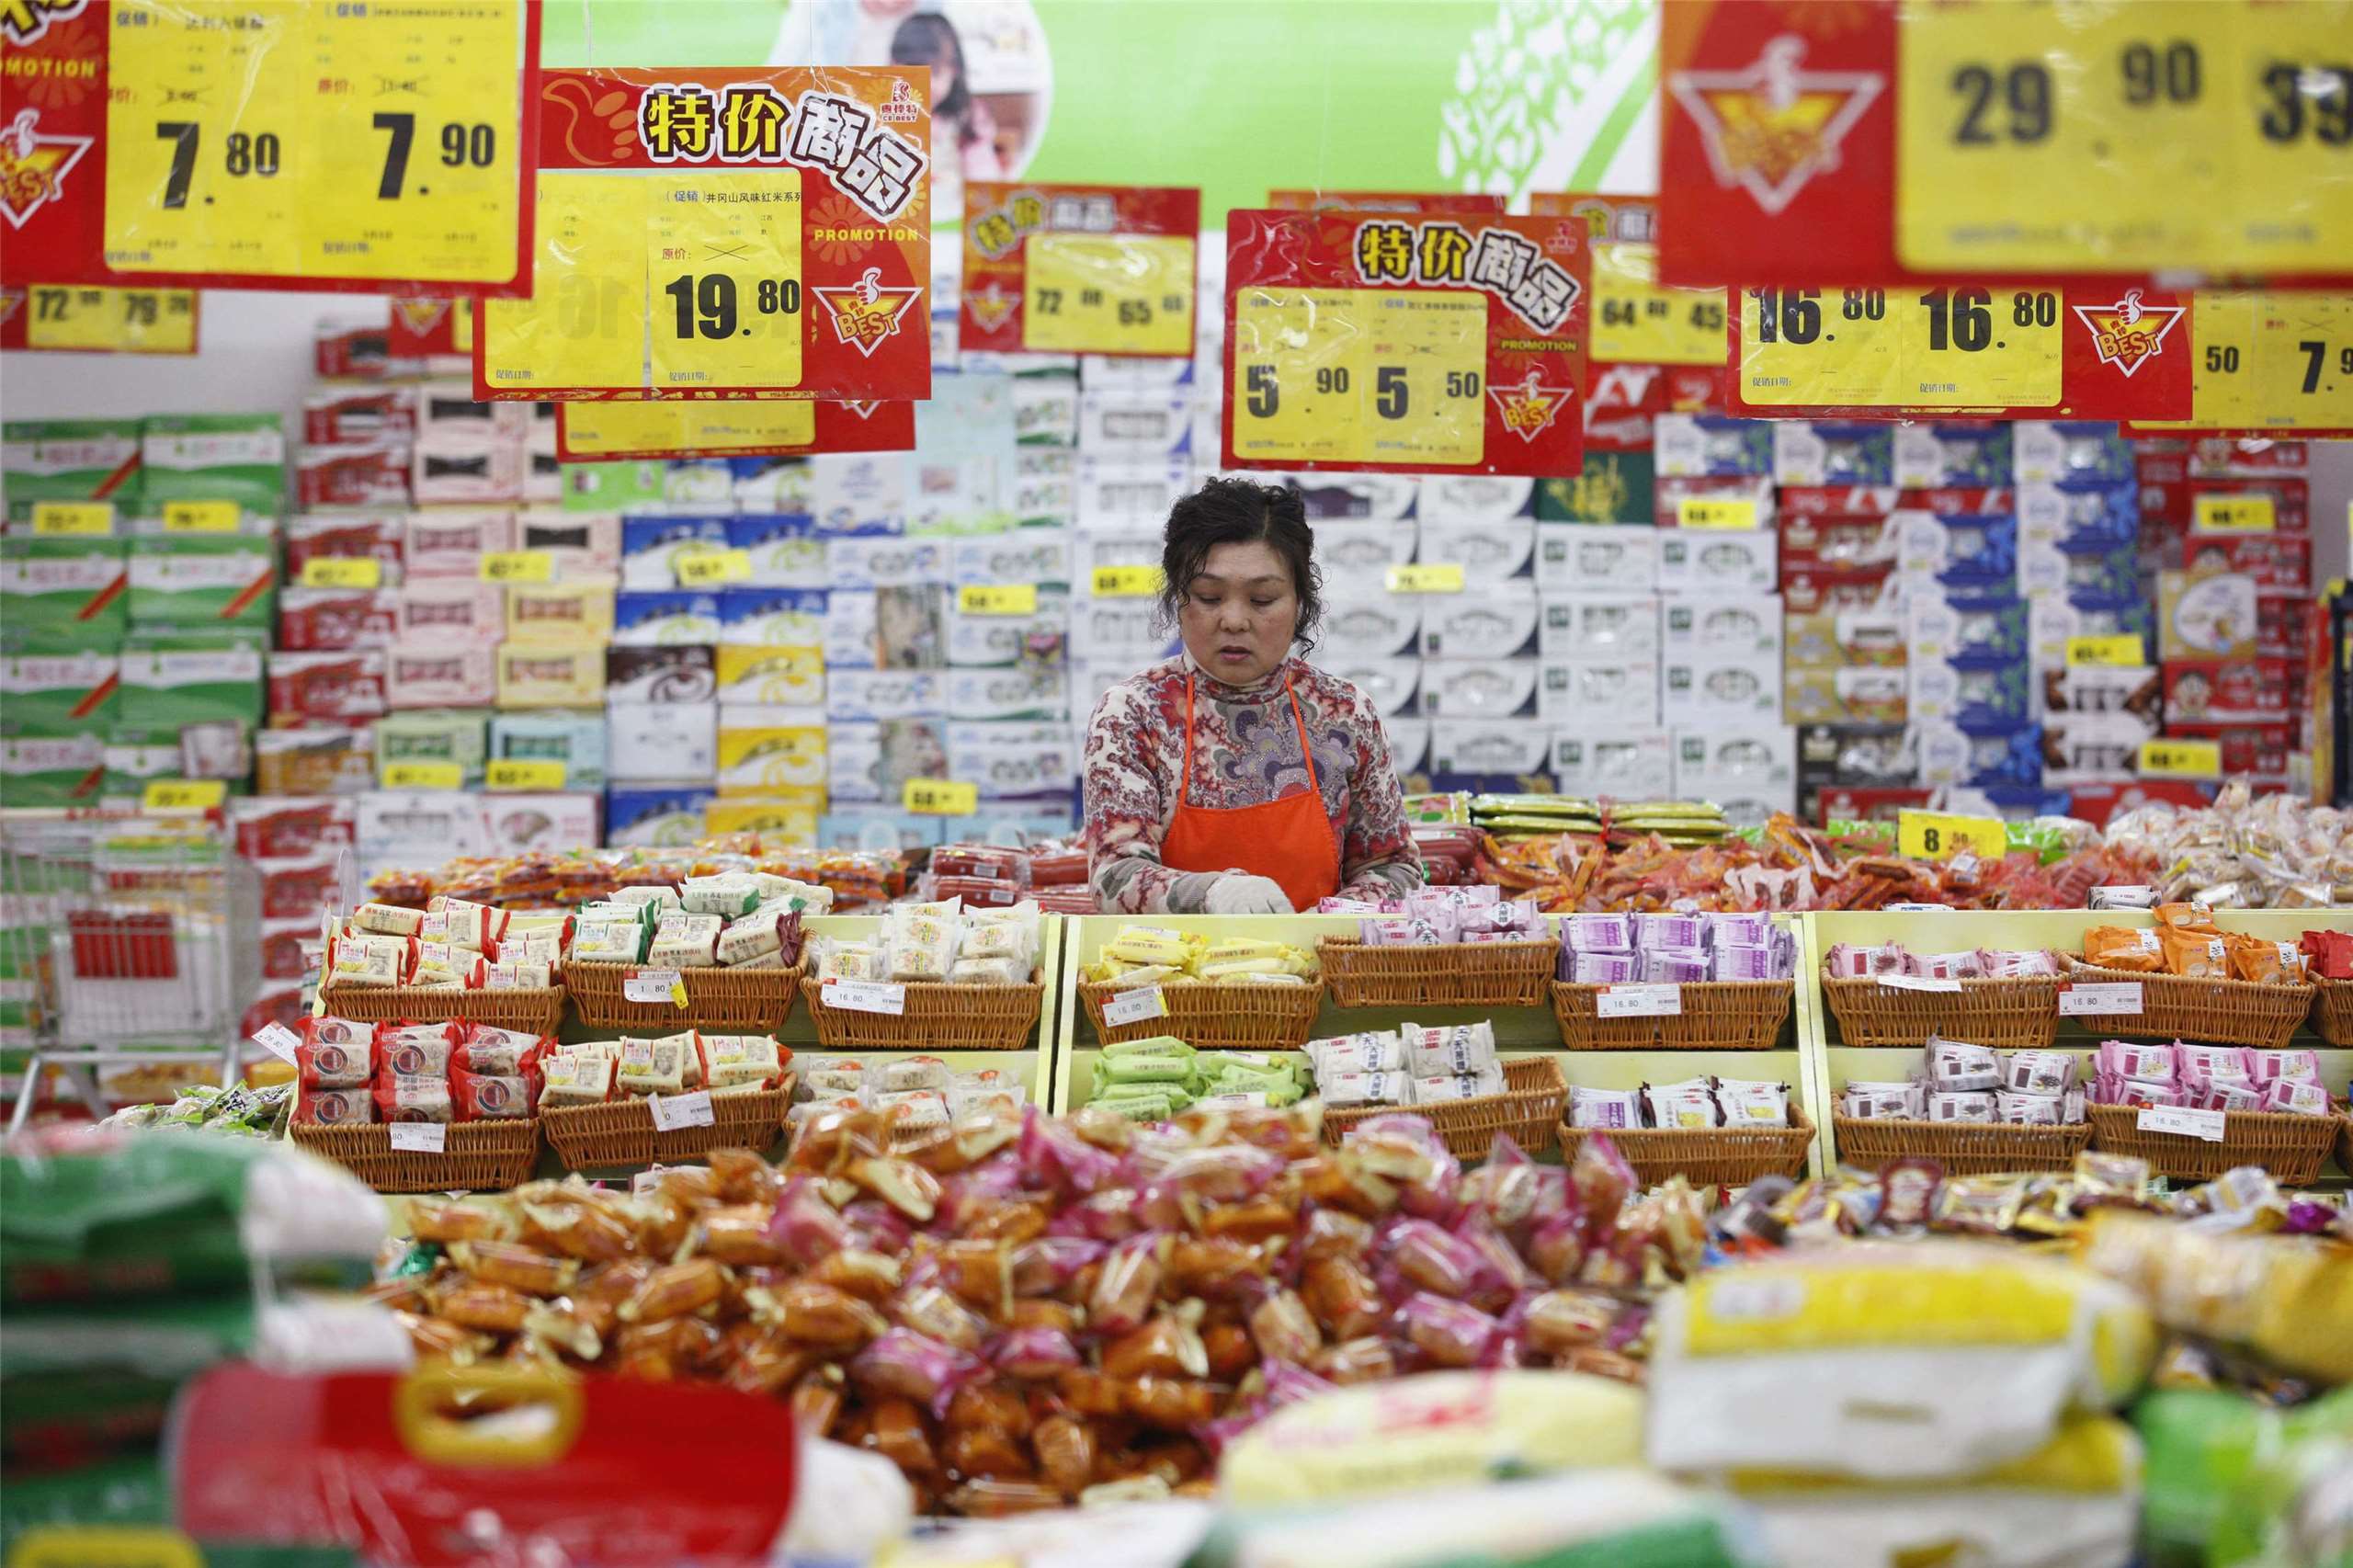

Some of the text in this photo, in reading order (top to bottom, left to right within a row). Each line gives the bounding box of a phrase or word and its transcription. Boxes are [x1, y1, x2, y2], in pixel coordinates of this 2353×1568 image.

[0, 57, 96, 78] MOTION
[814, 229, 918, 242] PROMOTION
[836, 312, 899, 340] BEST
[1501, 339, 1577, 352] PROMOTION
[2096, 331, 2160, 359] BEST
[1505, 406, 1553, 427] BEST
